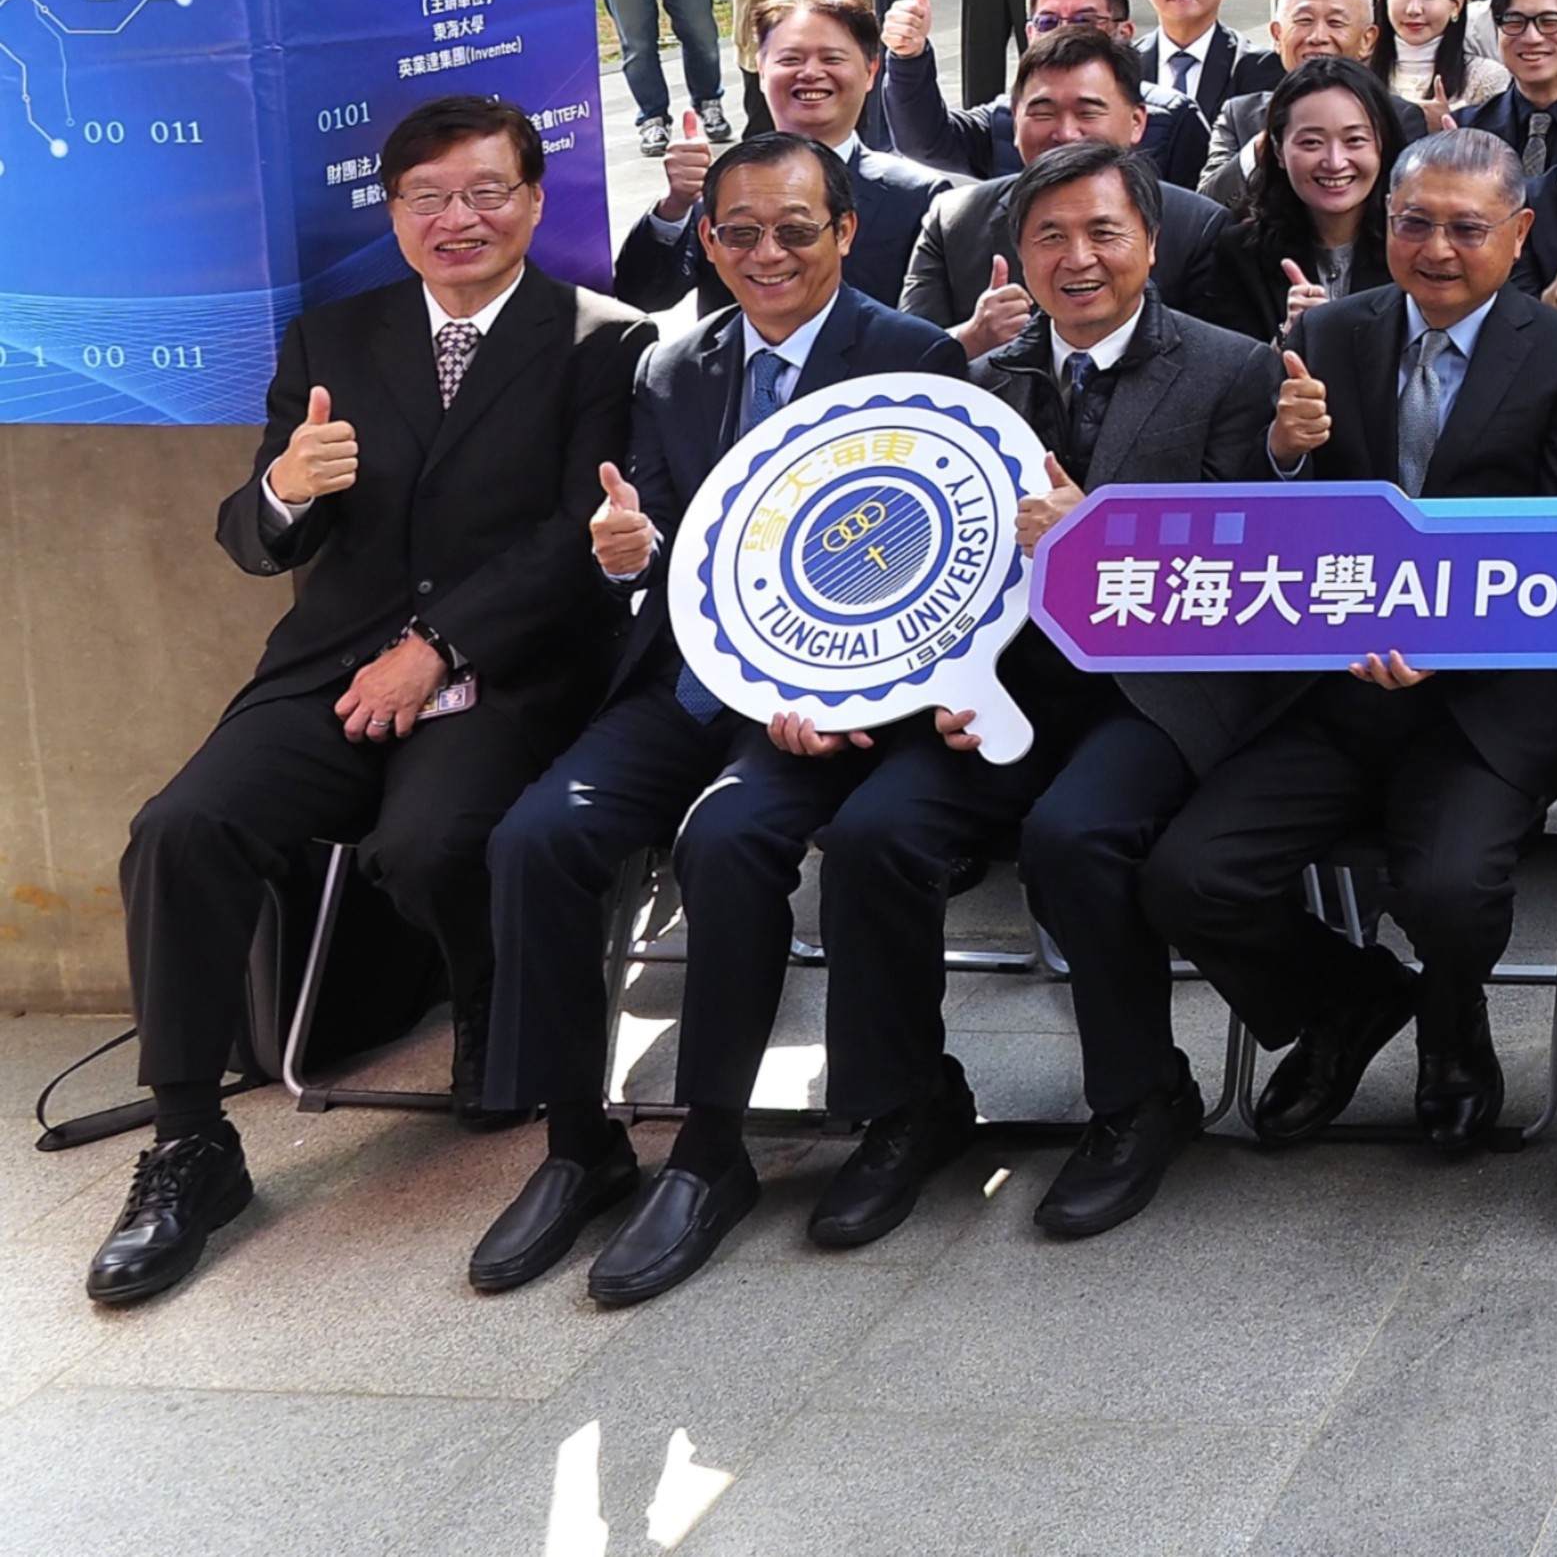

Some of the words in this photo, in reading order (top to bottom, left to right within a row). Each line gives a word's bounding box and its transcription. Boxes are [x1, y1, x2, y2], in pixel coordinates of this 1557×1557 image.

[432, 14, 485, 43] 東海大學
[317, 101, 372, 133] 0101
[526, 100, 590, 131] 金會(TEFA)
[84, 121, 124, 144] 00
[150, 121, 203, 145] 011
[83, 345, 125, 369] 00
[151, 345, 206, 369] 011
[758, 595, 880, 662] TUNGHAI
[896, 474, 984, 645] UNIVERSITY
[1089, 552, 1452, 627] 東海大學AI
[907, 613, 977, 671] 1955
